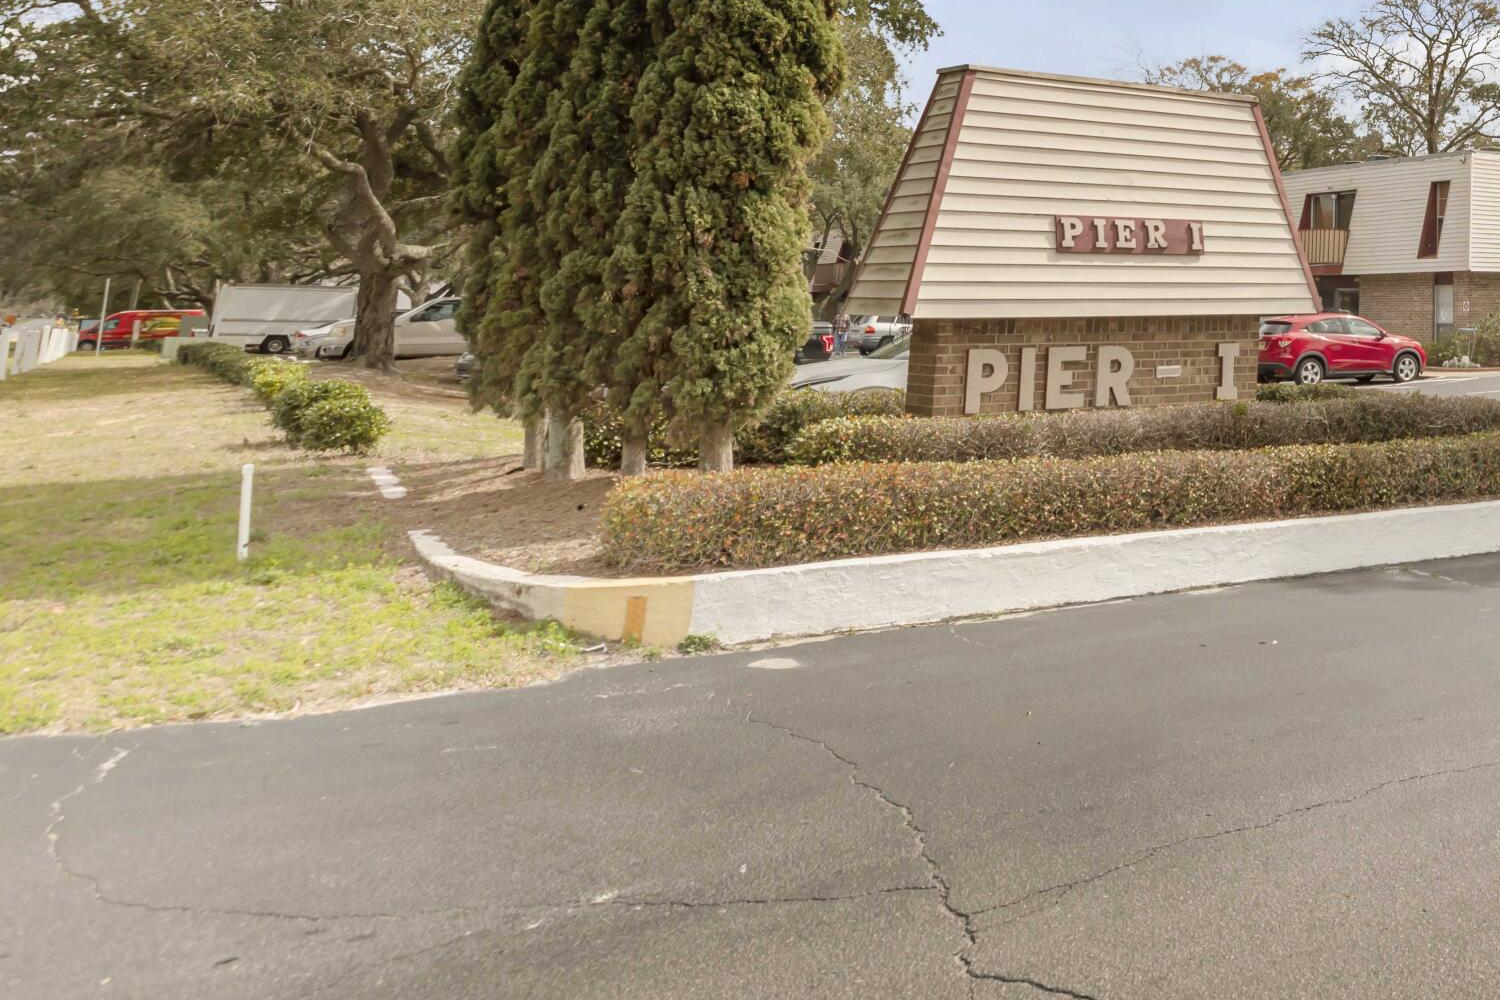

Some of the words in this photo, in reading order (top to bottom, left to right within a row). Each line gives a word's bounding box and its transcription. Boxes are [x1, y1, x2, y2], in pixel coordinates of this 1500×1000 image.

[1060, 217, 1168, 249] PIER
[964, 345, 1135, 415] PIER
[1216, 343, 1240, 400] I
